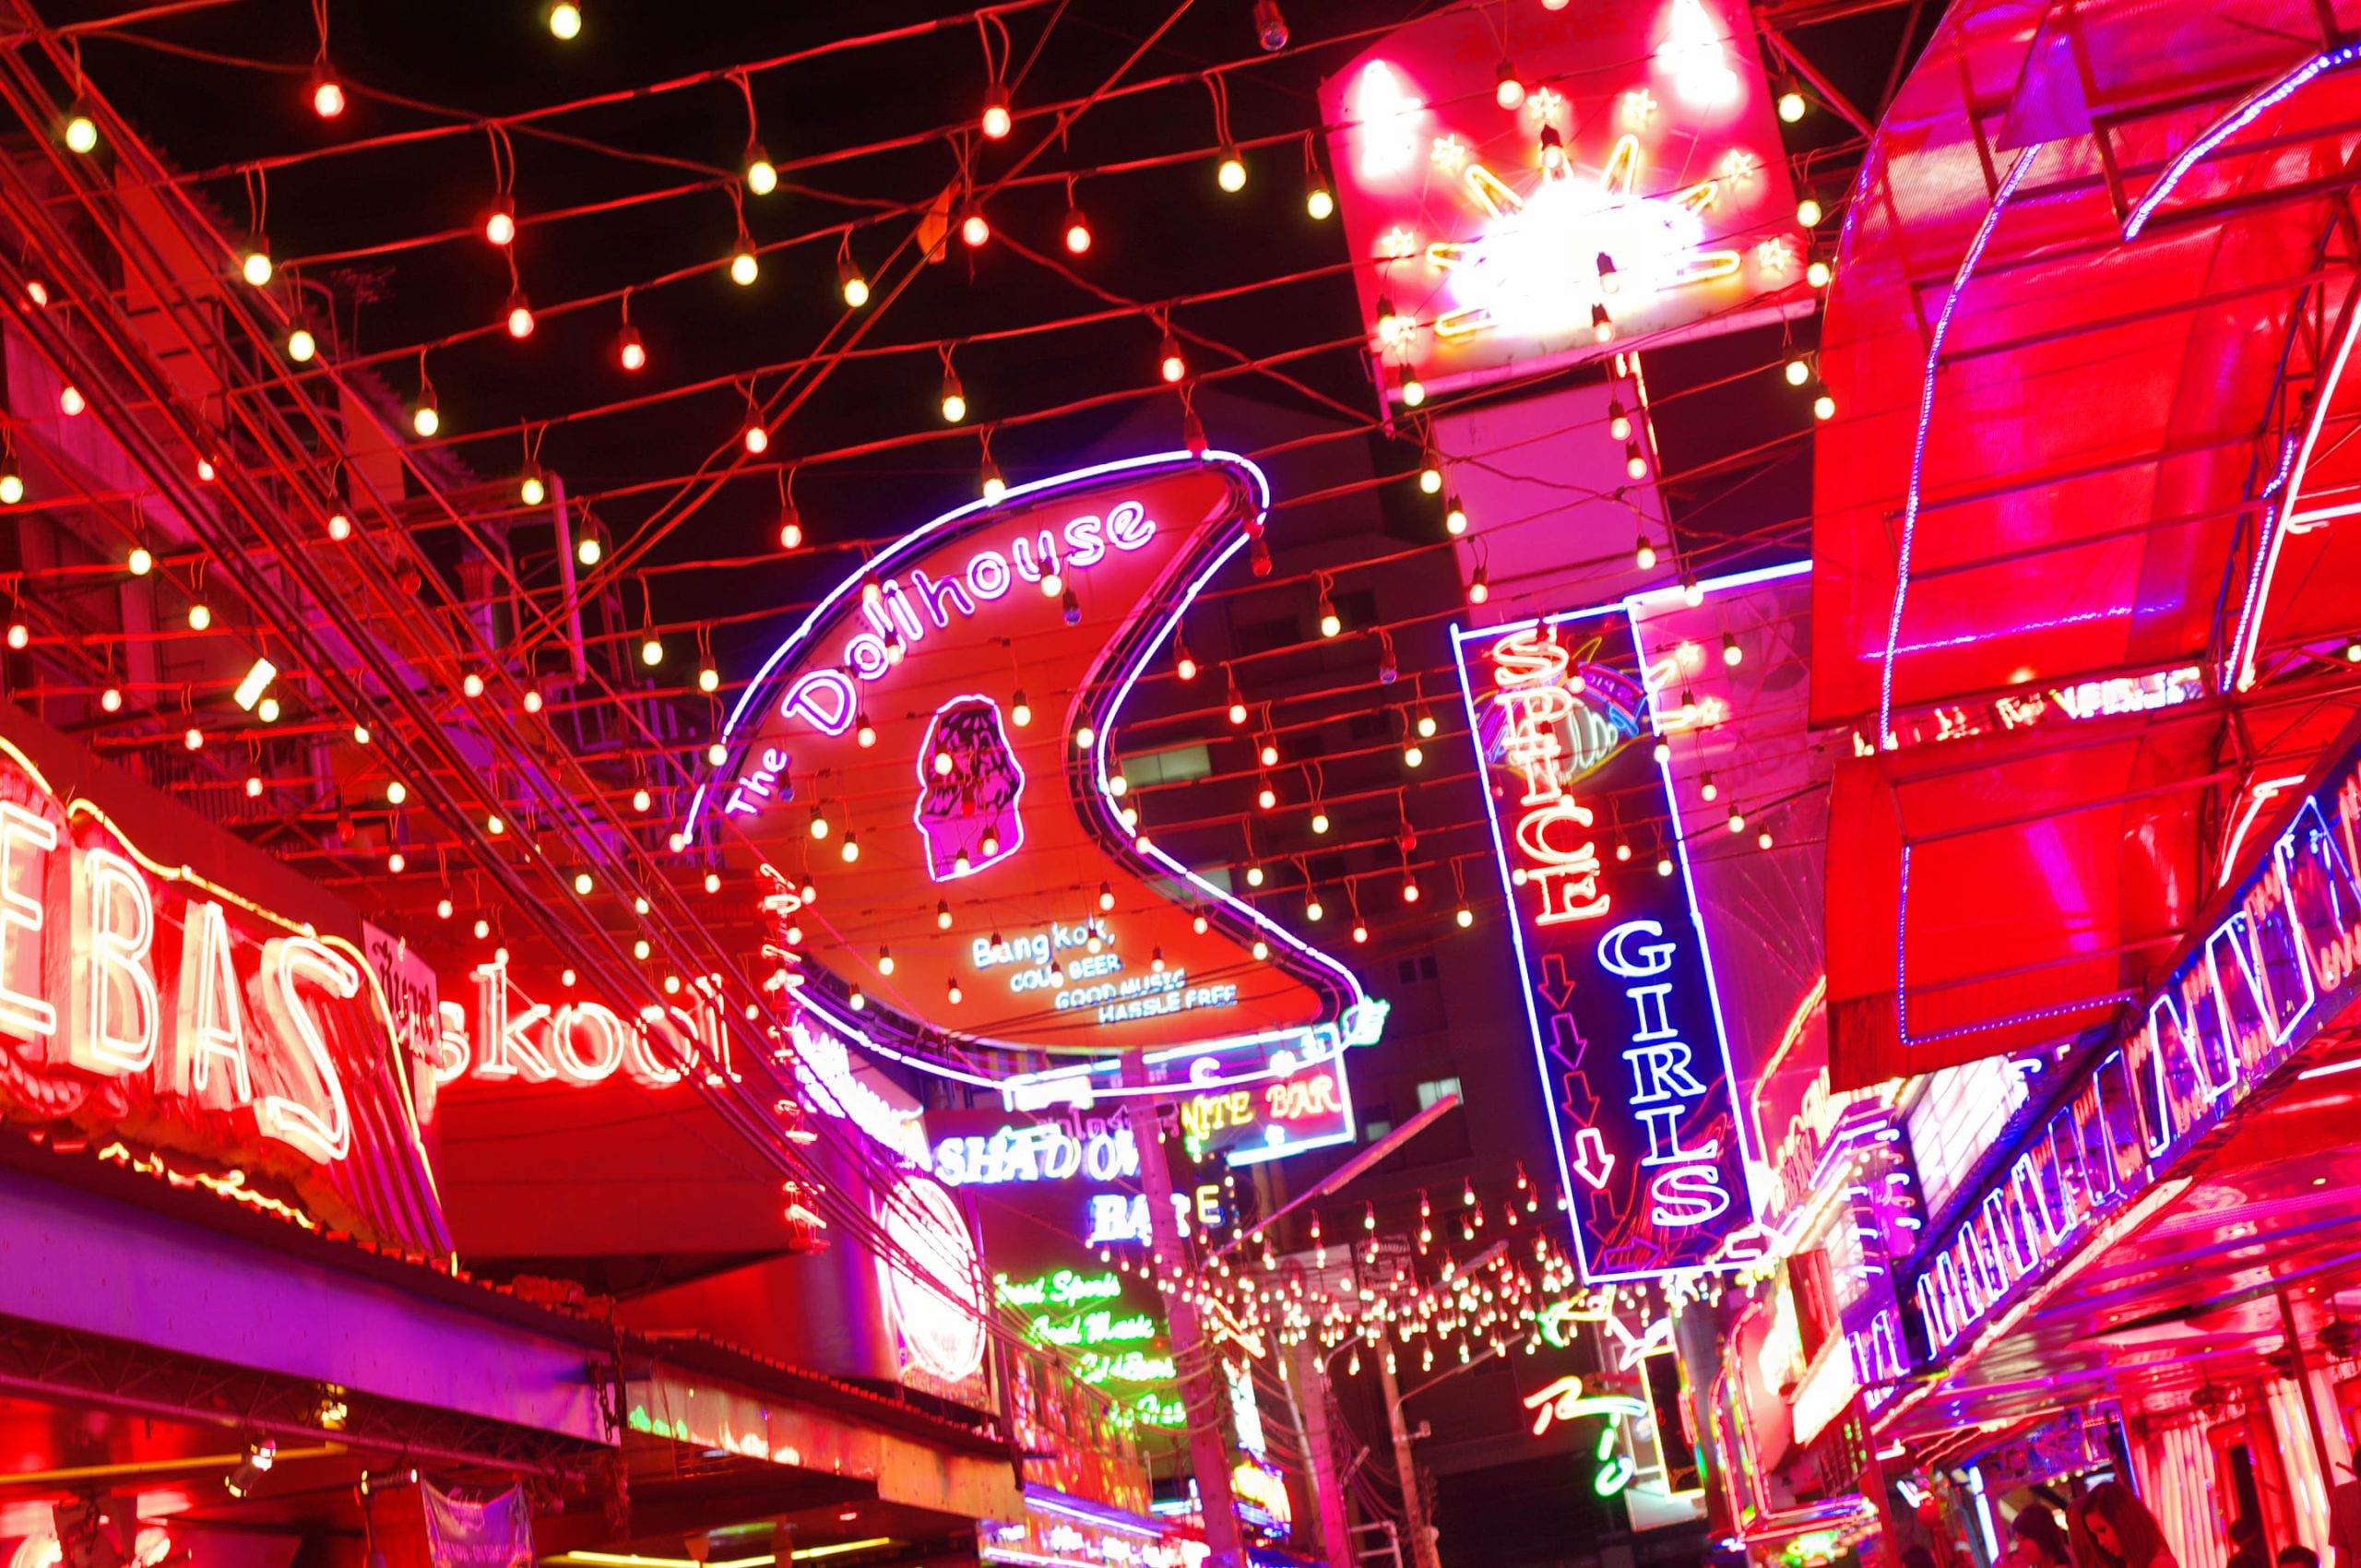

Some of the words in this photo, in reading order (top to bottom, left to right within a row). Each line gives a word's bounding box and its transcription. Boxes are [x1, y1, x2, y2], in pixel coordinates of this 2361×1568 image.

[726, 748, 788, 815] The
[782, 500, 1157, 736] Dollhouse
[1488, 621, 1610, 925] SPICE
[1597, 921, 1730, 1227] GIRLS
[1068, 954, 1122, 980] BEER
[1054, 984, 1117, 1010] GOOD
[1120, 969, 1186, 999] MUSIC
[1098, 991, 1181, 1025] HASSLE
[1185, 985, 1238, 1009] FREE
[1266, 1075, 1341, 1119] BAR
